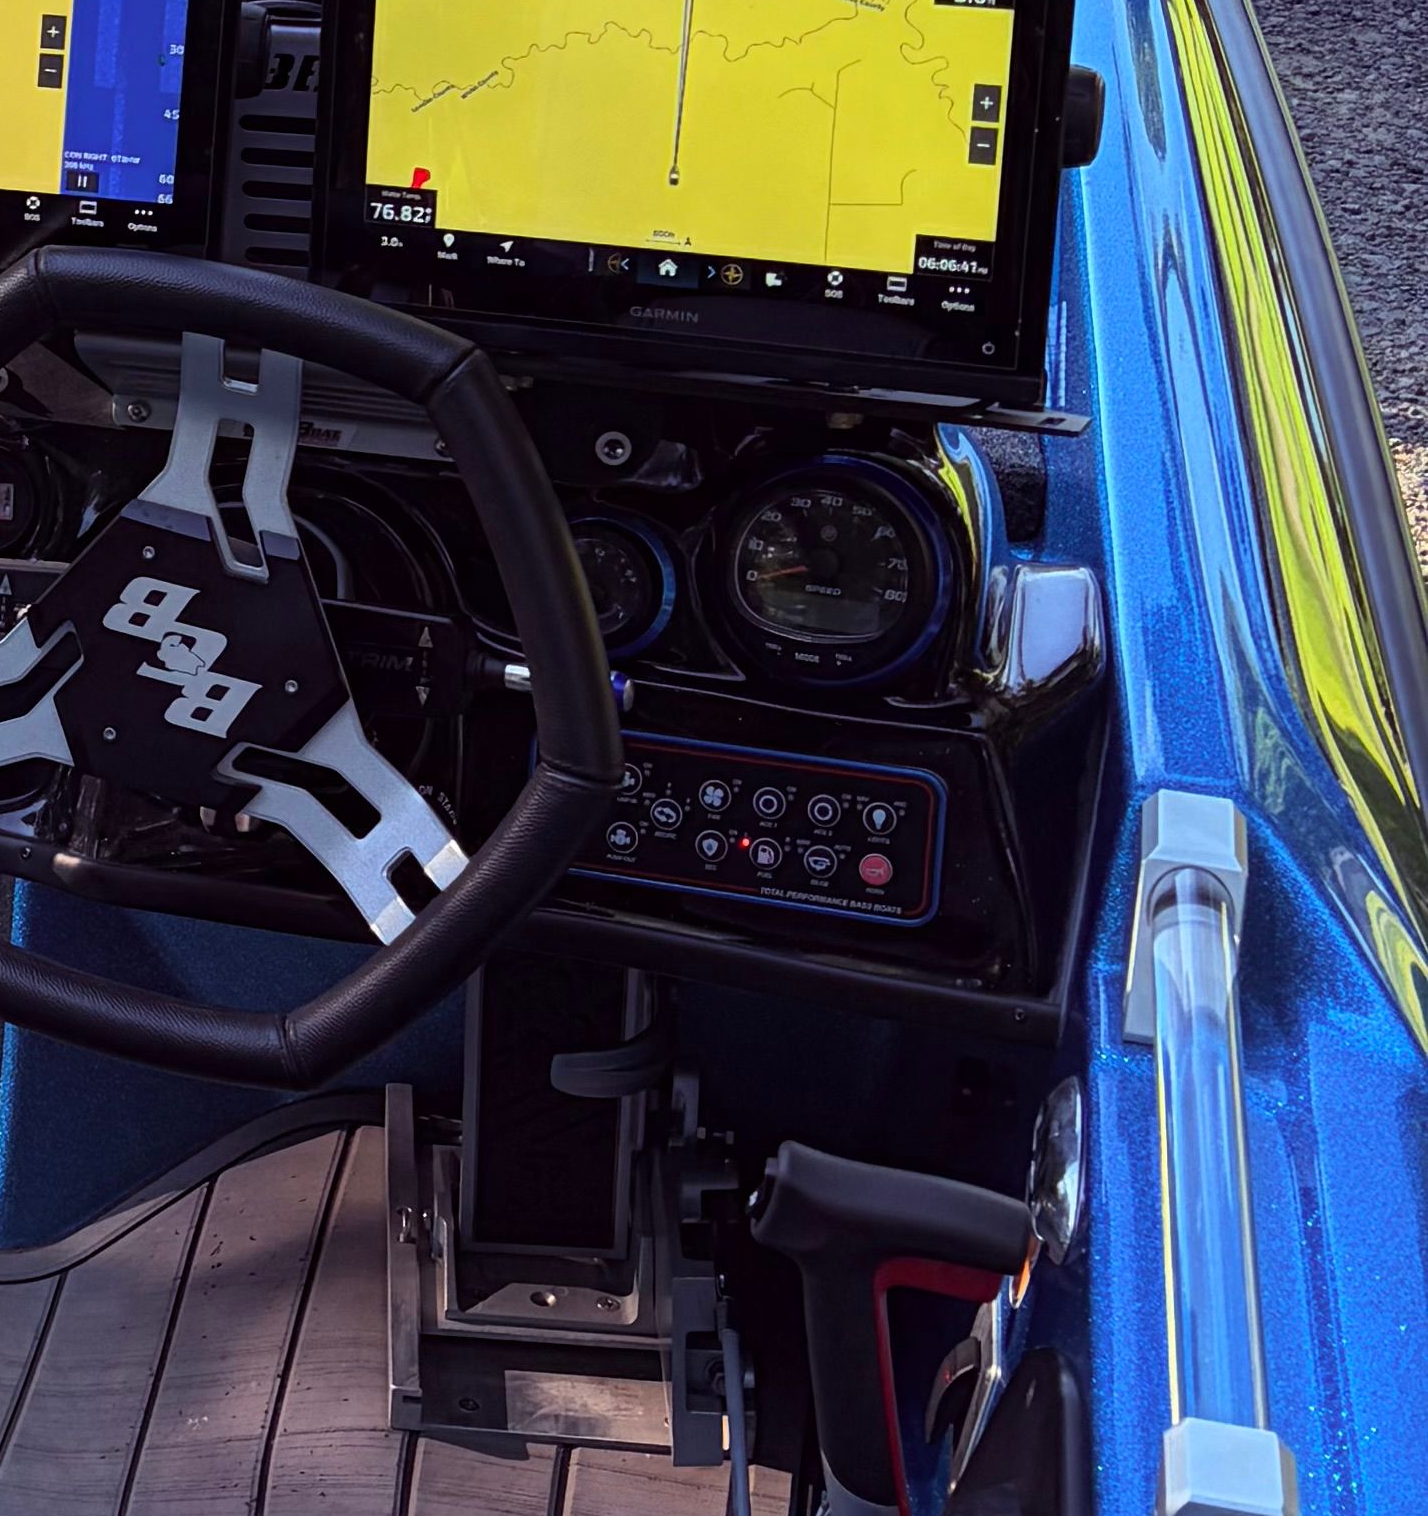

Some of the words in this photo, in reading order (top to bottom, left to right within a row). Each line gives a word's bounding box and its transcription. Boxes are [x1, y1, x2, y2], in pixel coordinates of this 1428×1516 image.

[629, 305, 699, 323] GARMIN
[761, 511, 782, 522] 20
[790, 497, 812, 509] 30
[820, 496, 843, 507] 40
[760, 886, 785, 898] TOTAL
[786, 889, 848, 908] PERFORMANCE
